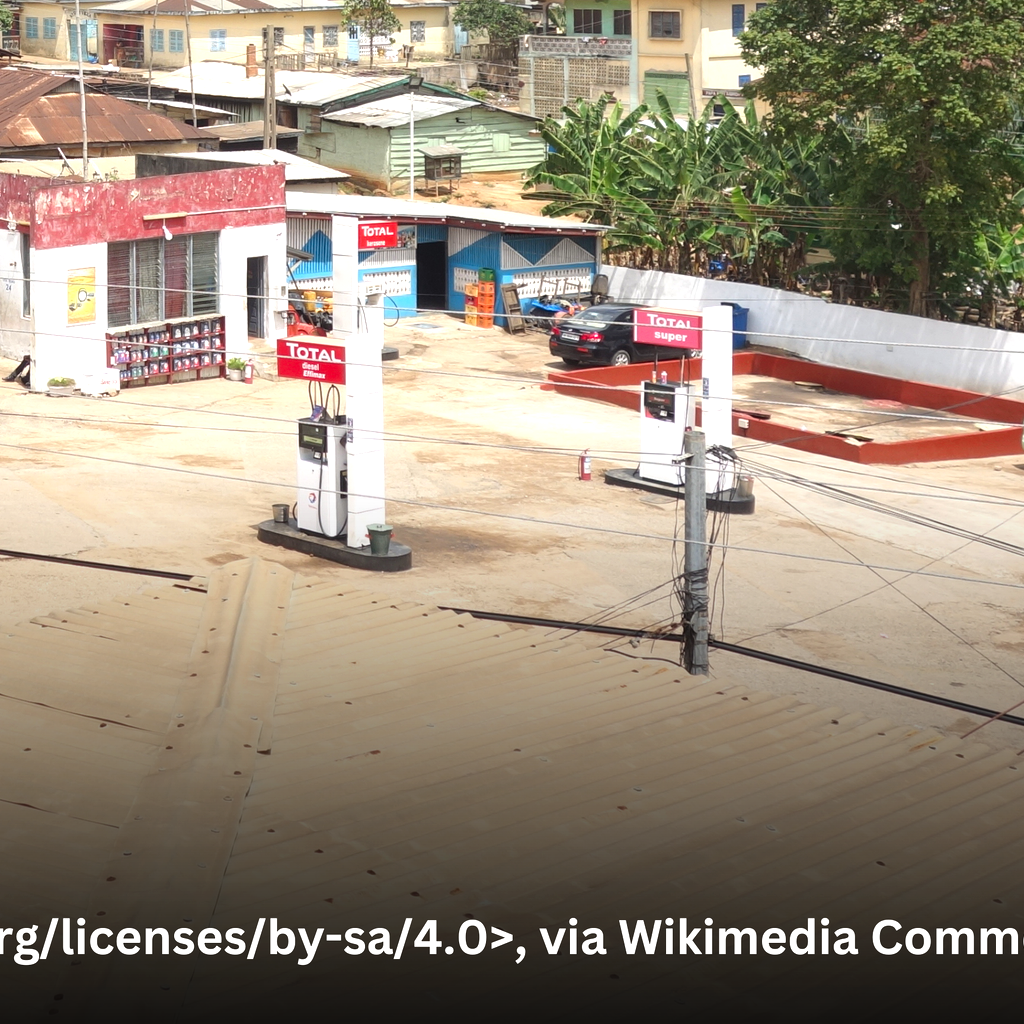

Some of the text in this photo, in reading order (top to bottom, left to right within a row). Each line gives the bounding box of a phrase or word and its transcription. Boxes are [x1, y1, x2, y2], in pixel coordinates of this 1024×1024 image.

[361, 226, 394, 237] TOTAL
[646, 313, 692, 329] TOTAL
[654, 330, 688, 342] super
[286, 342, 342, 363] TOTAL
[302, 362, 320, 371] diesel
[303, 370, 326, 379] Effimax
